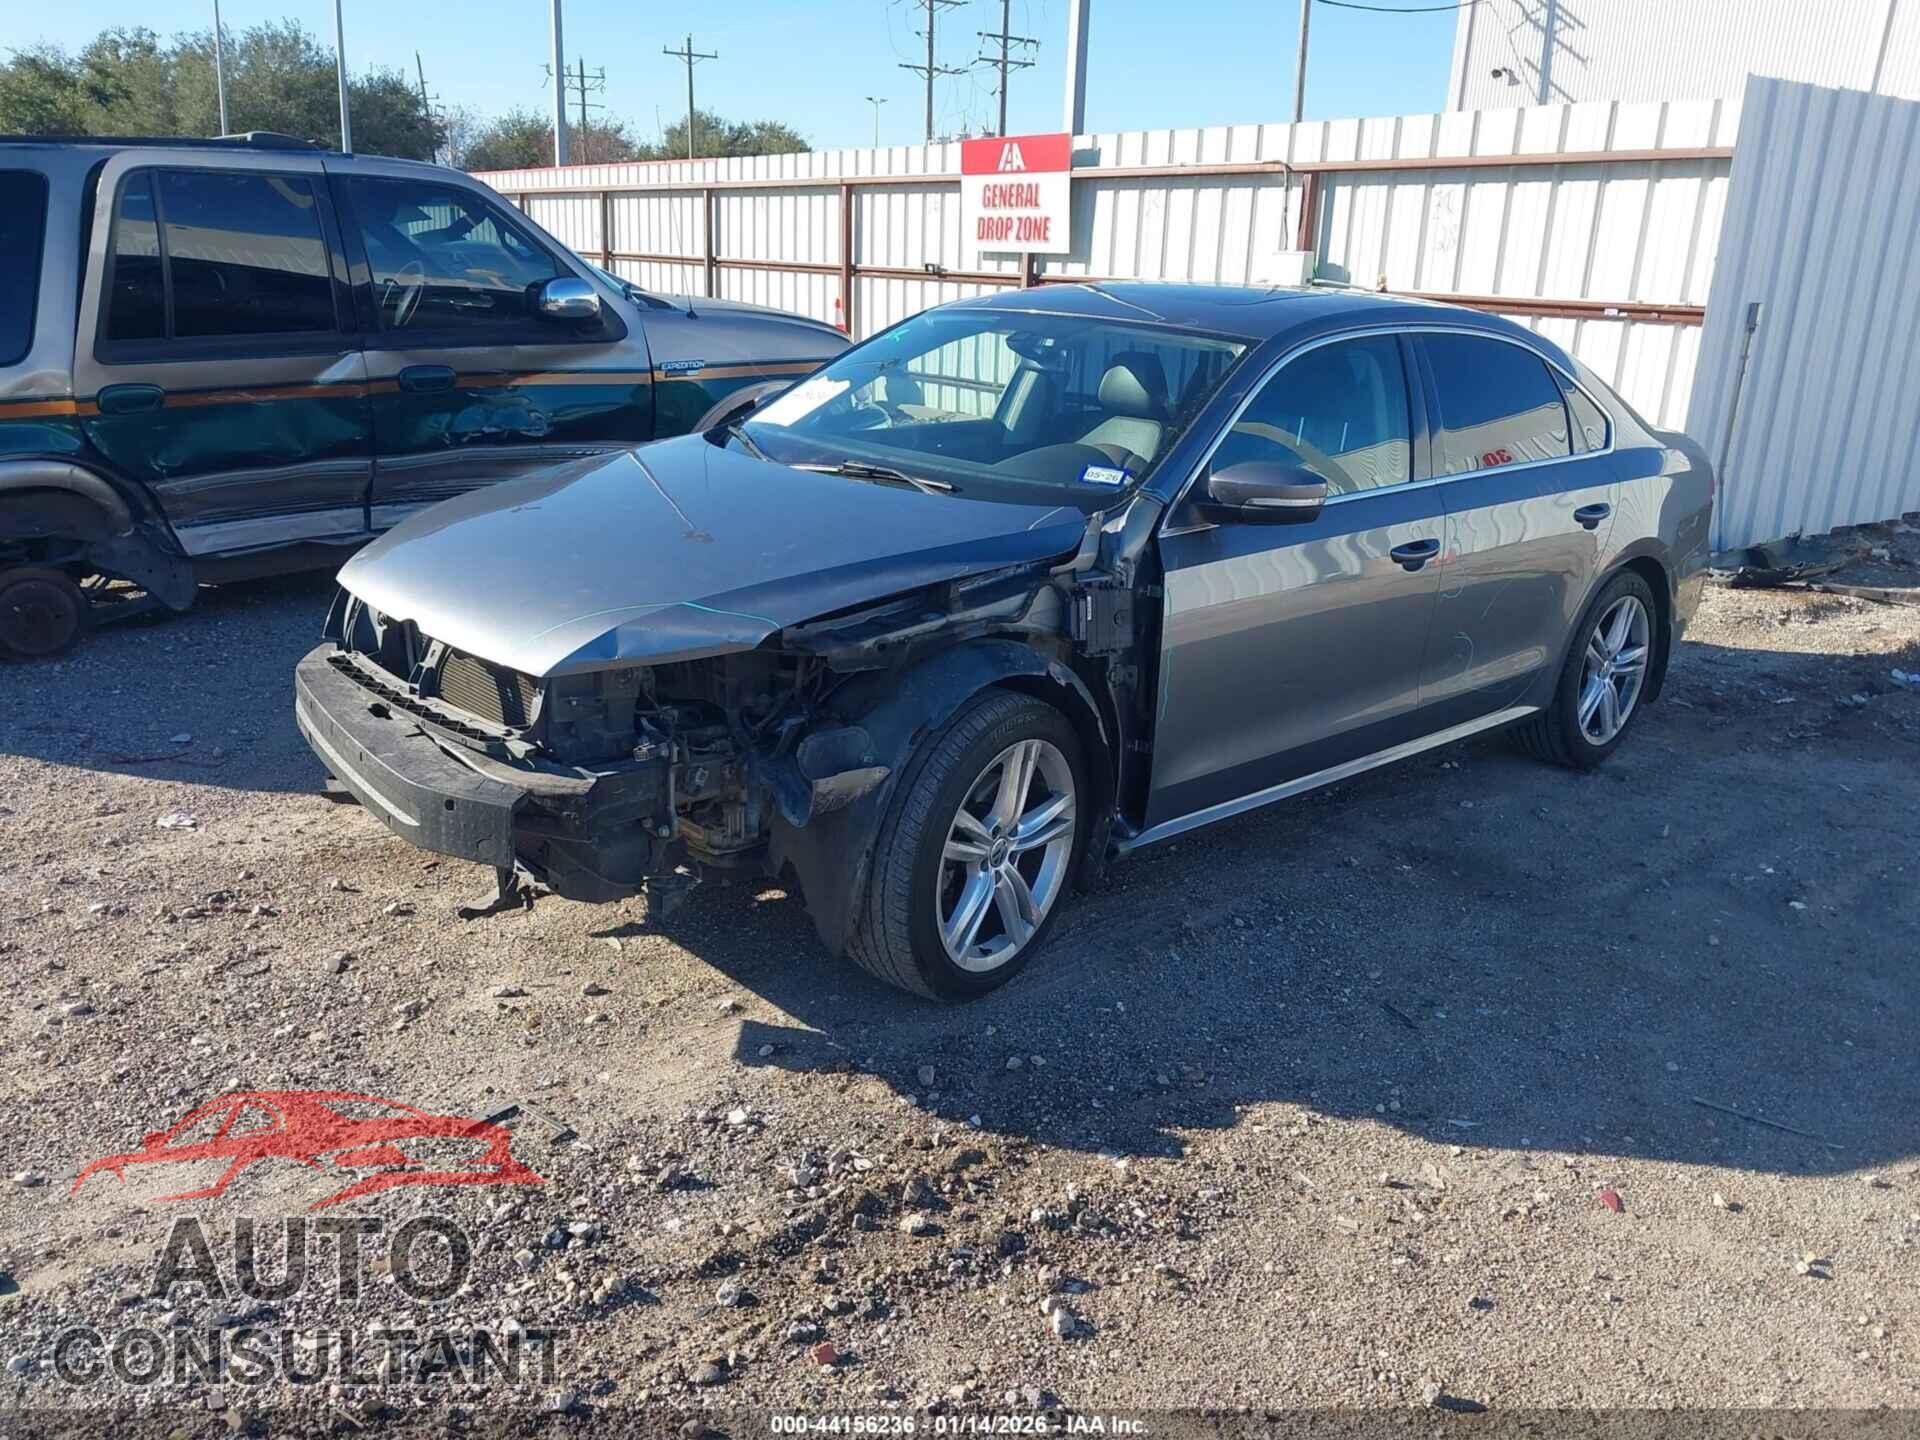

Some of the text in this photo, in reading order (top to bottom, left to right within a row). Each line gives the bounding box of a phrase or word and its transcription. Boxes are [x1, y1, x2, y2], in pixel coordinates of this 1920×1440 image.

[983, 183, 1040, 208] GENERAL
[977, 217, 1050, 241] DROP ZONE
[661, 361, 704, 370] EXPEDITION
